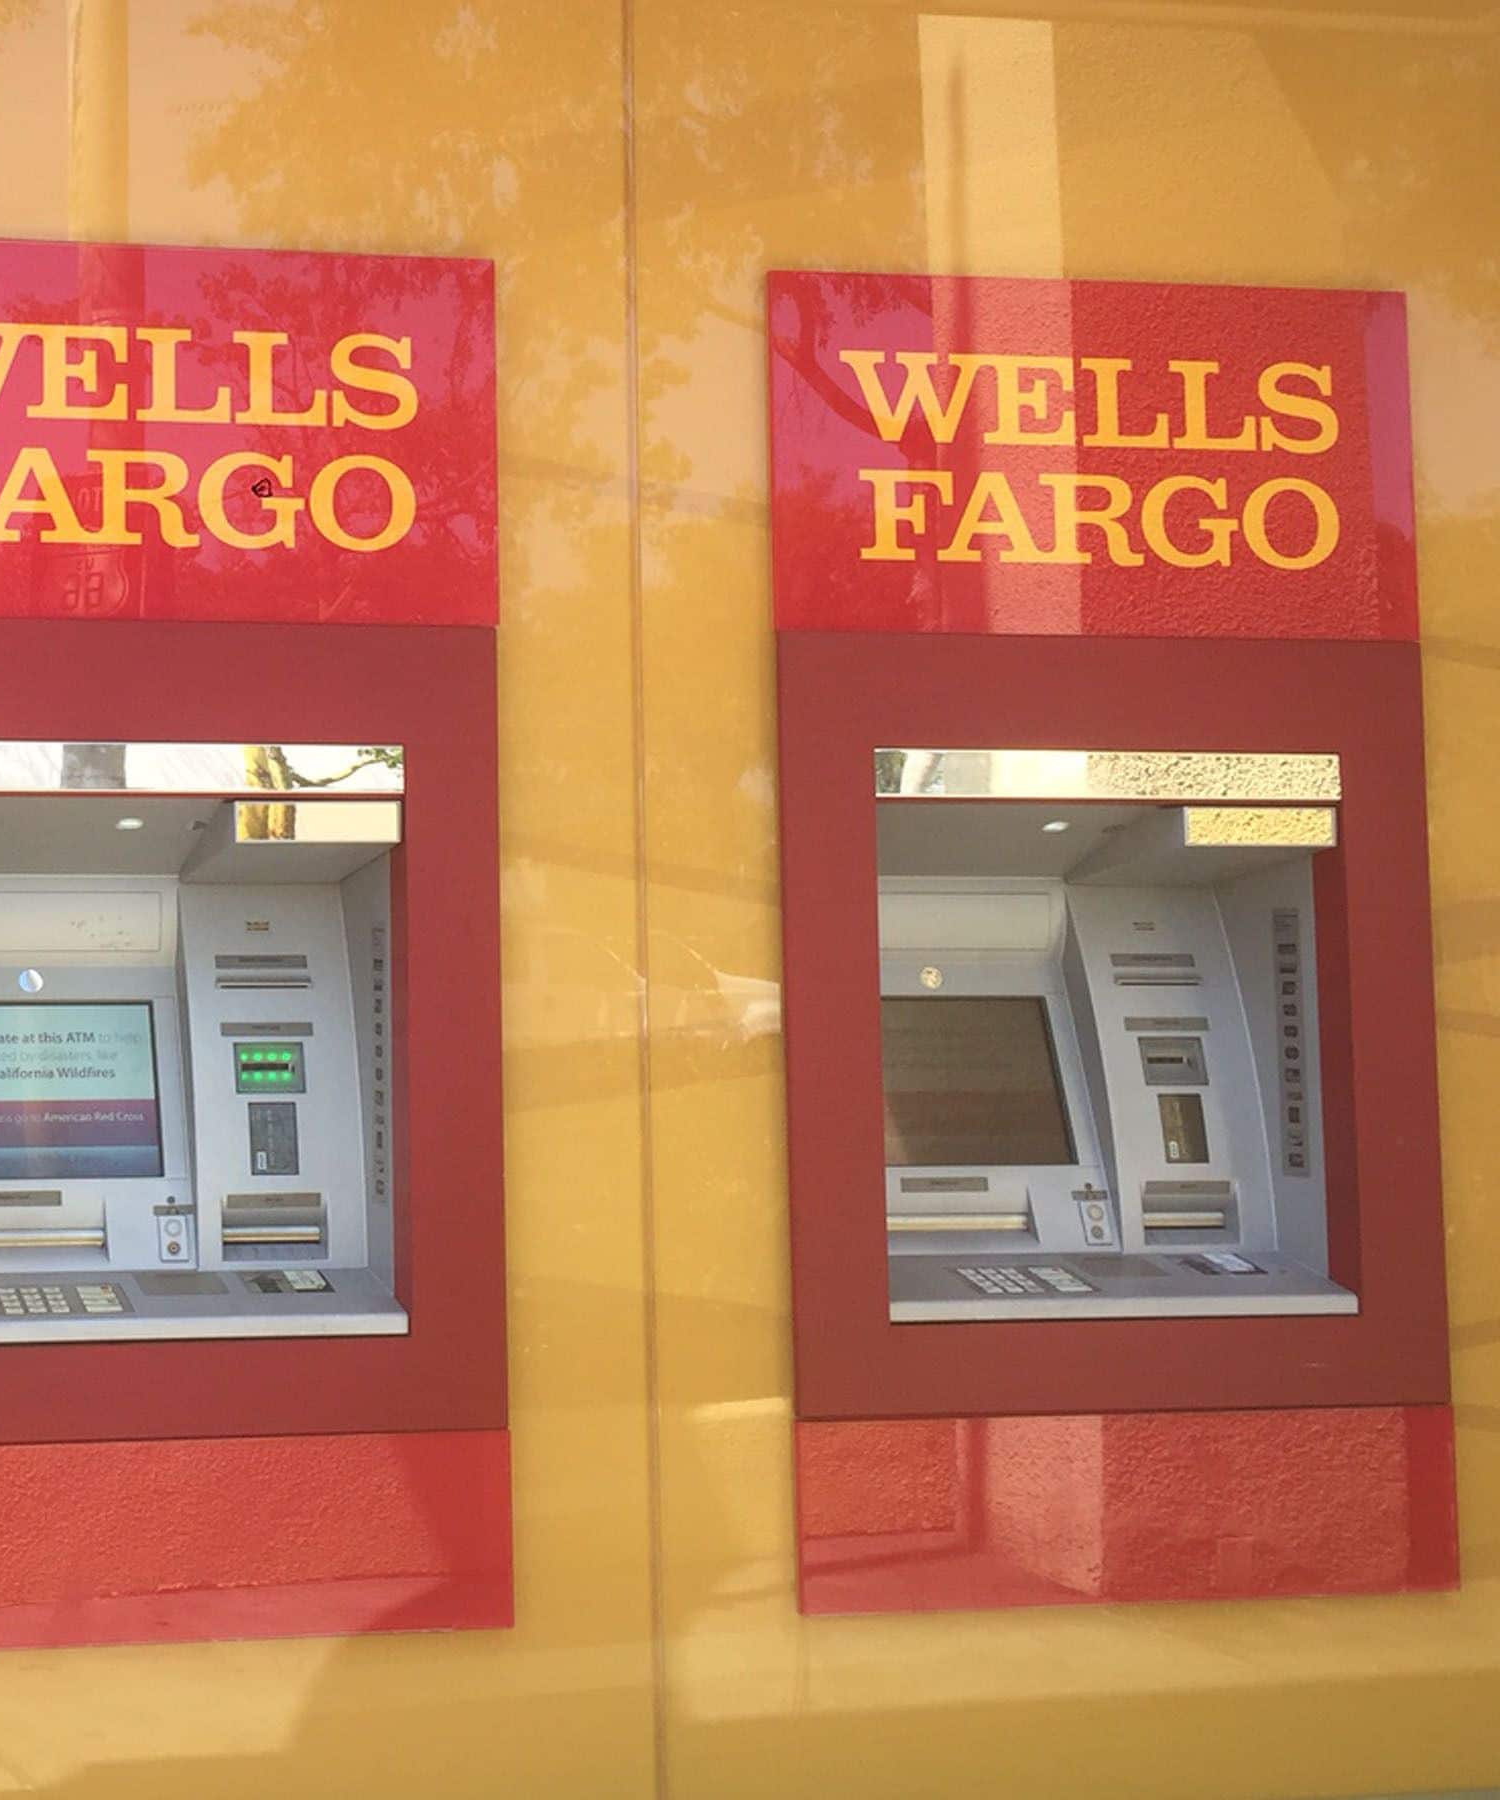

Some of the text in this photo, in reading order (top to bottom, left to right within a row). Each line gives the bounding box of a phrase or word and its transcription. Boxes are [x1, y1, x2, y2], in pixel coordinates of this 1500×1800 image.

[840, 350, 1339, 454] WELLS
[859, 469, 1340, 570] FARGO
[22, 1033, 36, 1044] at
[38, 1031, 63, 1044] this
[66, 1031, 95, 1043] ATM
[56, 1066, 116, 1079] Wildfires
[44, 1111, 92, 1121] American
[94, 1110, 115, 1121] Red
[116, 1110, 144, 1121] Cross
